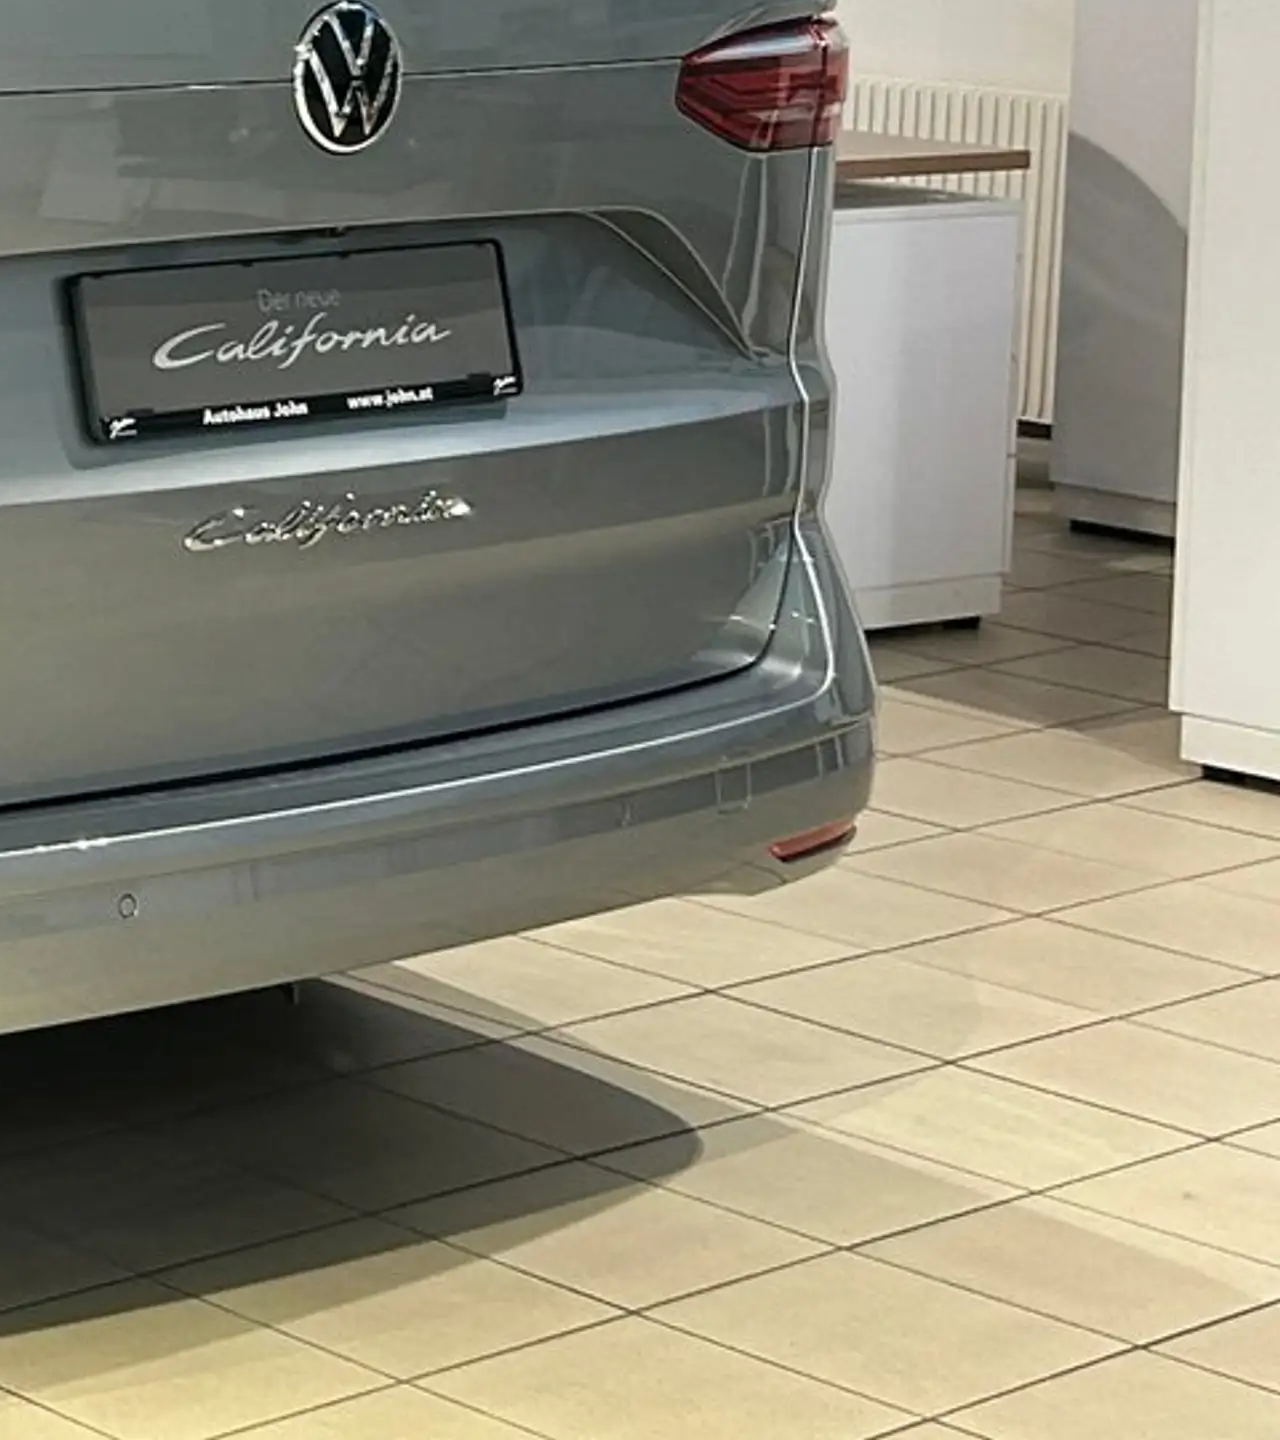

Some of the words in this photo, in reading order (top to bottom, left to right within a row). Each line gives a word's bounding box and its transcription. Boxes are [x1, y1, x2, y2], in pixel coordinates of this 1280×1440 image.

[257, 287, 288, 313] Der
[151, 312, 453, 370] California
[202, 405, 271, 426] Autohaus
[272, 400, 309, 420] John
[346, 386, 434, 410] www.john.at
[181, 489, 473, 552] California
